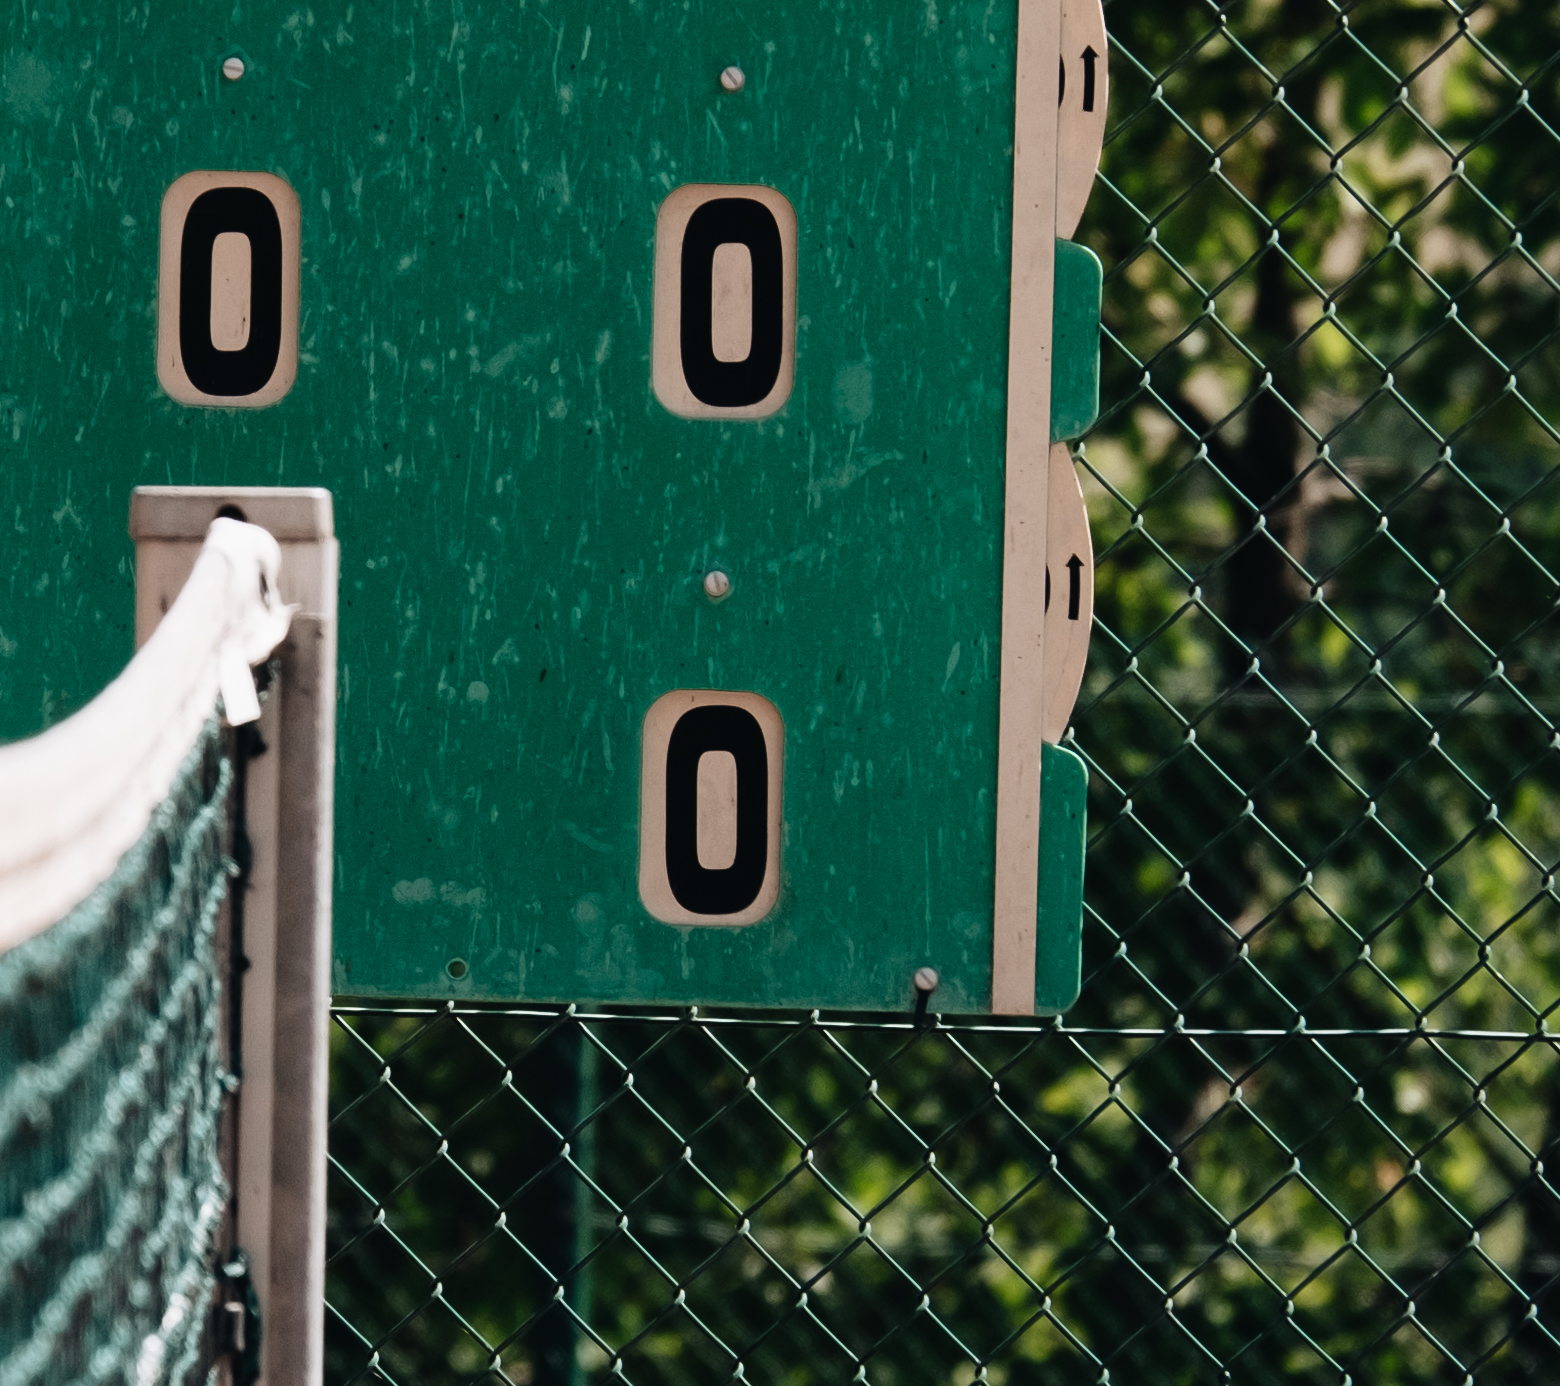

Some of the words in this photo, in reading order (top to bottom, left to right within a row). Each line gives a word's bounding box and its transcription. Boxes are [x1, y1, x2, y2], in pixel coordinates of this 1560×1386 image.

[178, 186, 282, 397] 0
[679, 196, 783, 409] 0
[665, 705, 769, 916] 0
